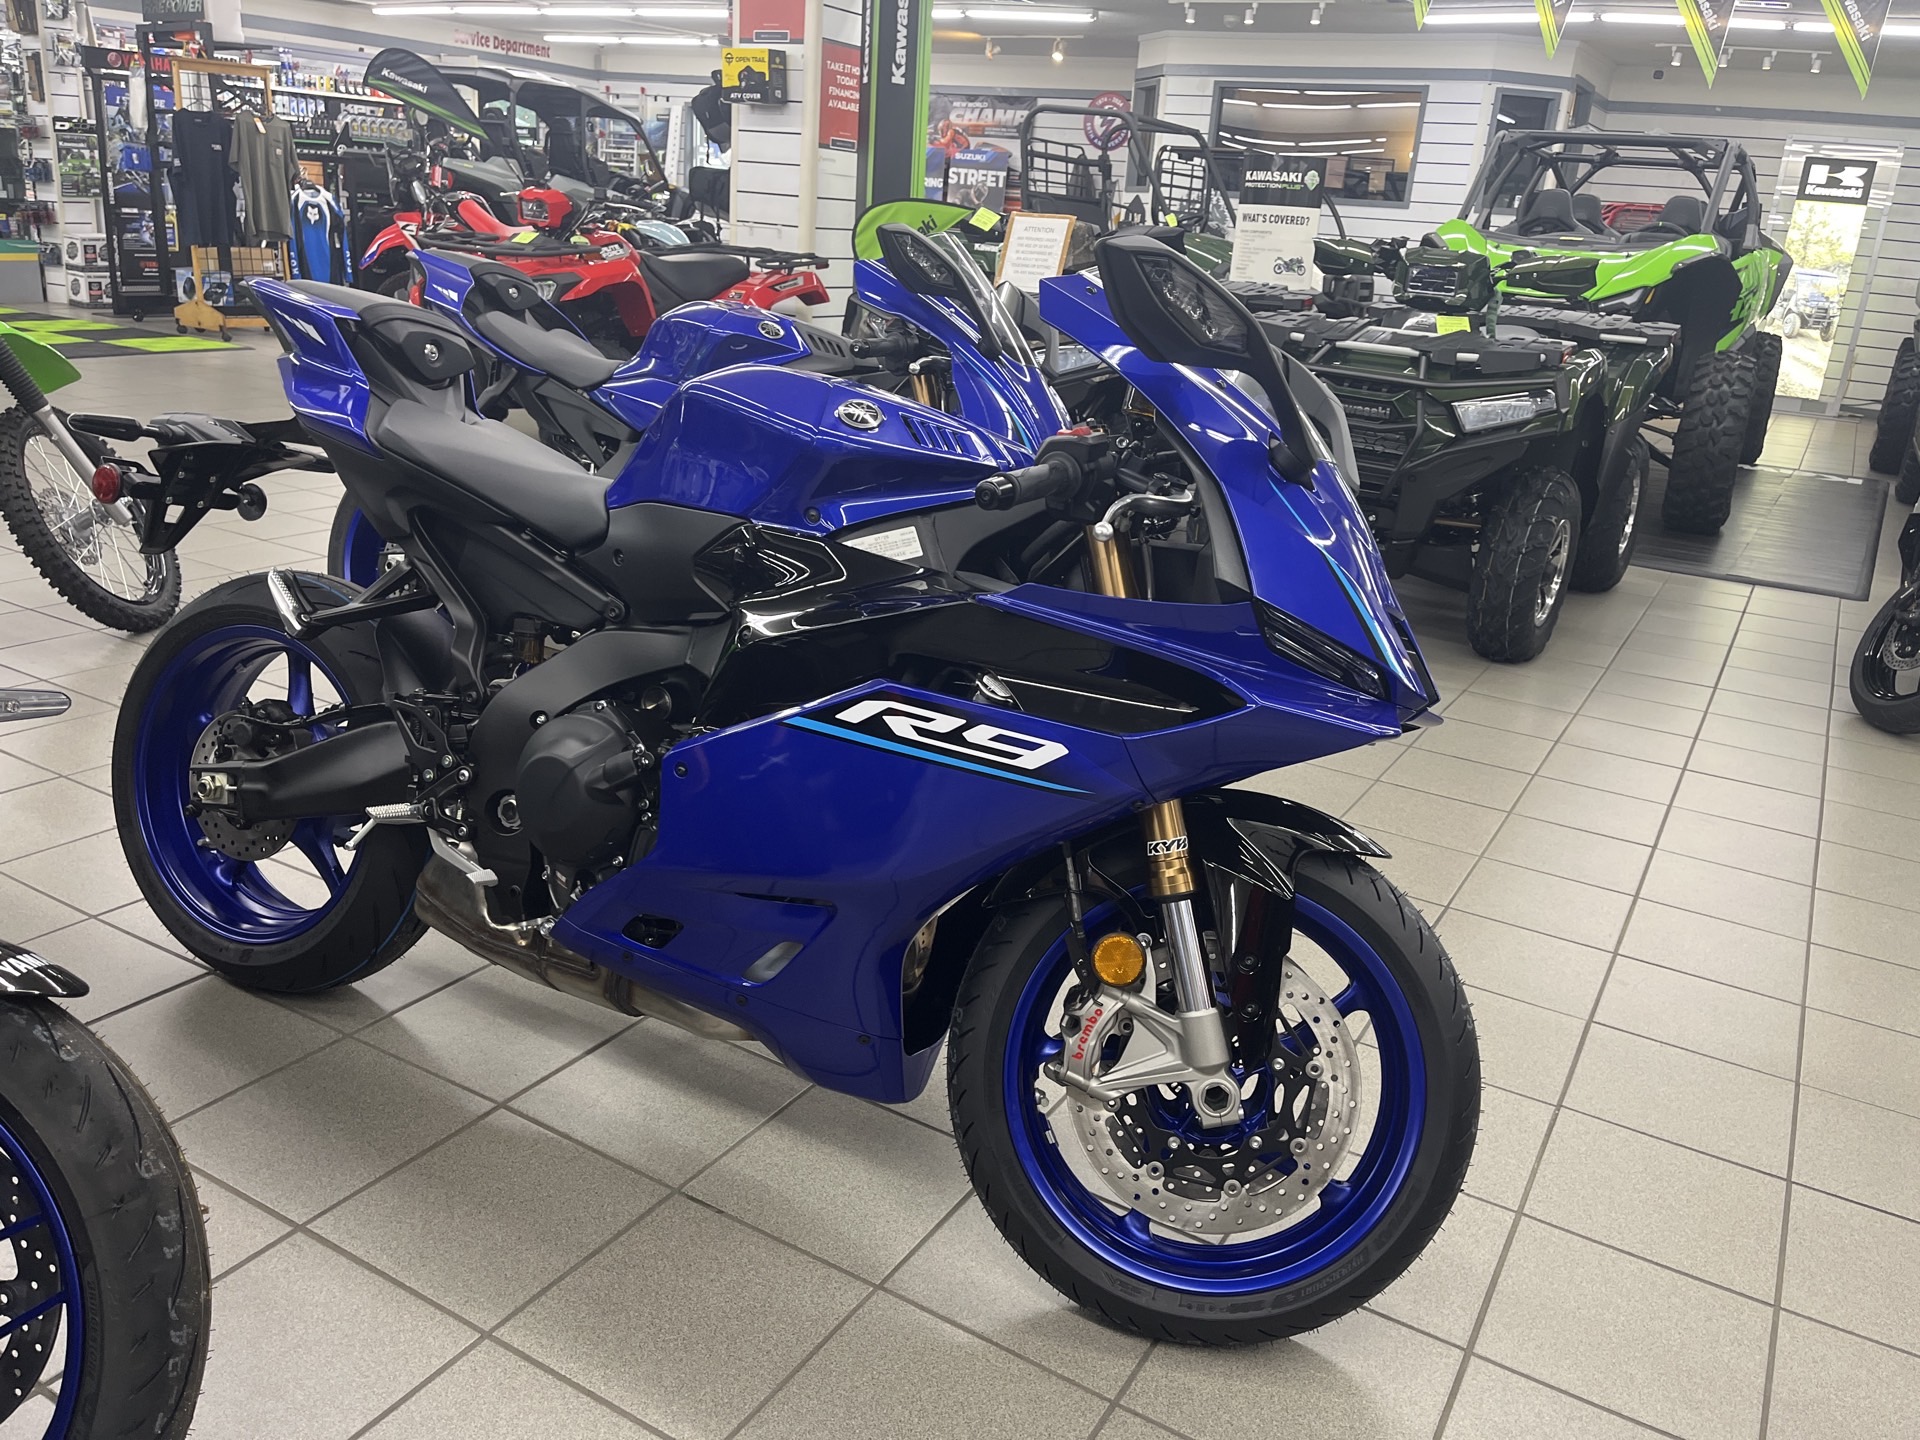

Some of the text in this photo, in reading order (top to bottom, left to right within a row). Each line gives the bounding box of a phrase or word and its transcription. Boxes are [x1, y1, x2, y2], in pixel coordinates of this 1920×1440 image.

[454, 29, 551, 59] Service Department
[826, 60, 844, 73] TAKE
[845, 63, 851, 74] IT
[381, 67, 428, 94] Kawasaki
[828, 100, 860, 113] AVAILABLE
[955, 152, 986, 161] SUZUKI
[948, 167, 1006, 188] STREET
[1245, 170, 1302, 182] KAWASAKI
[1804, 184, 1863, 199] Kawasaki
[1242, 212, 1310, 226] WHAT'S COVERED?
[835, 700, 1070, 770] R9
[1147, 836, 1189, 856] KYB
[1072, 1008, 1104, 1061] brembo
